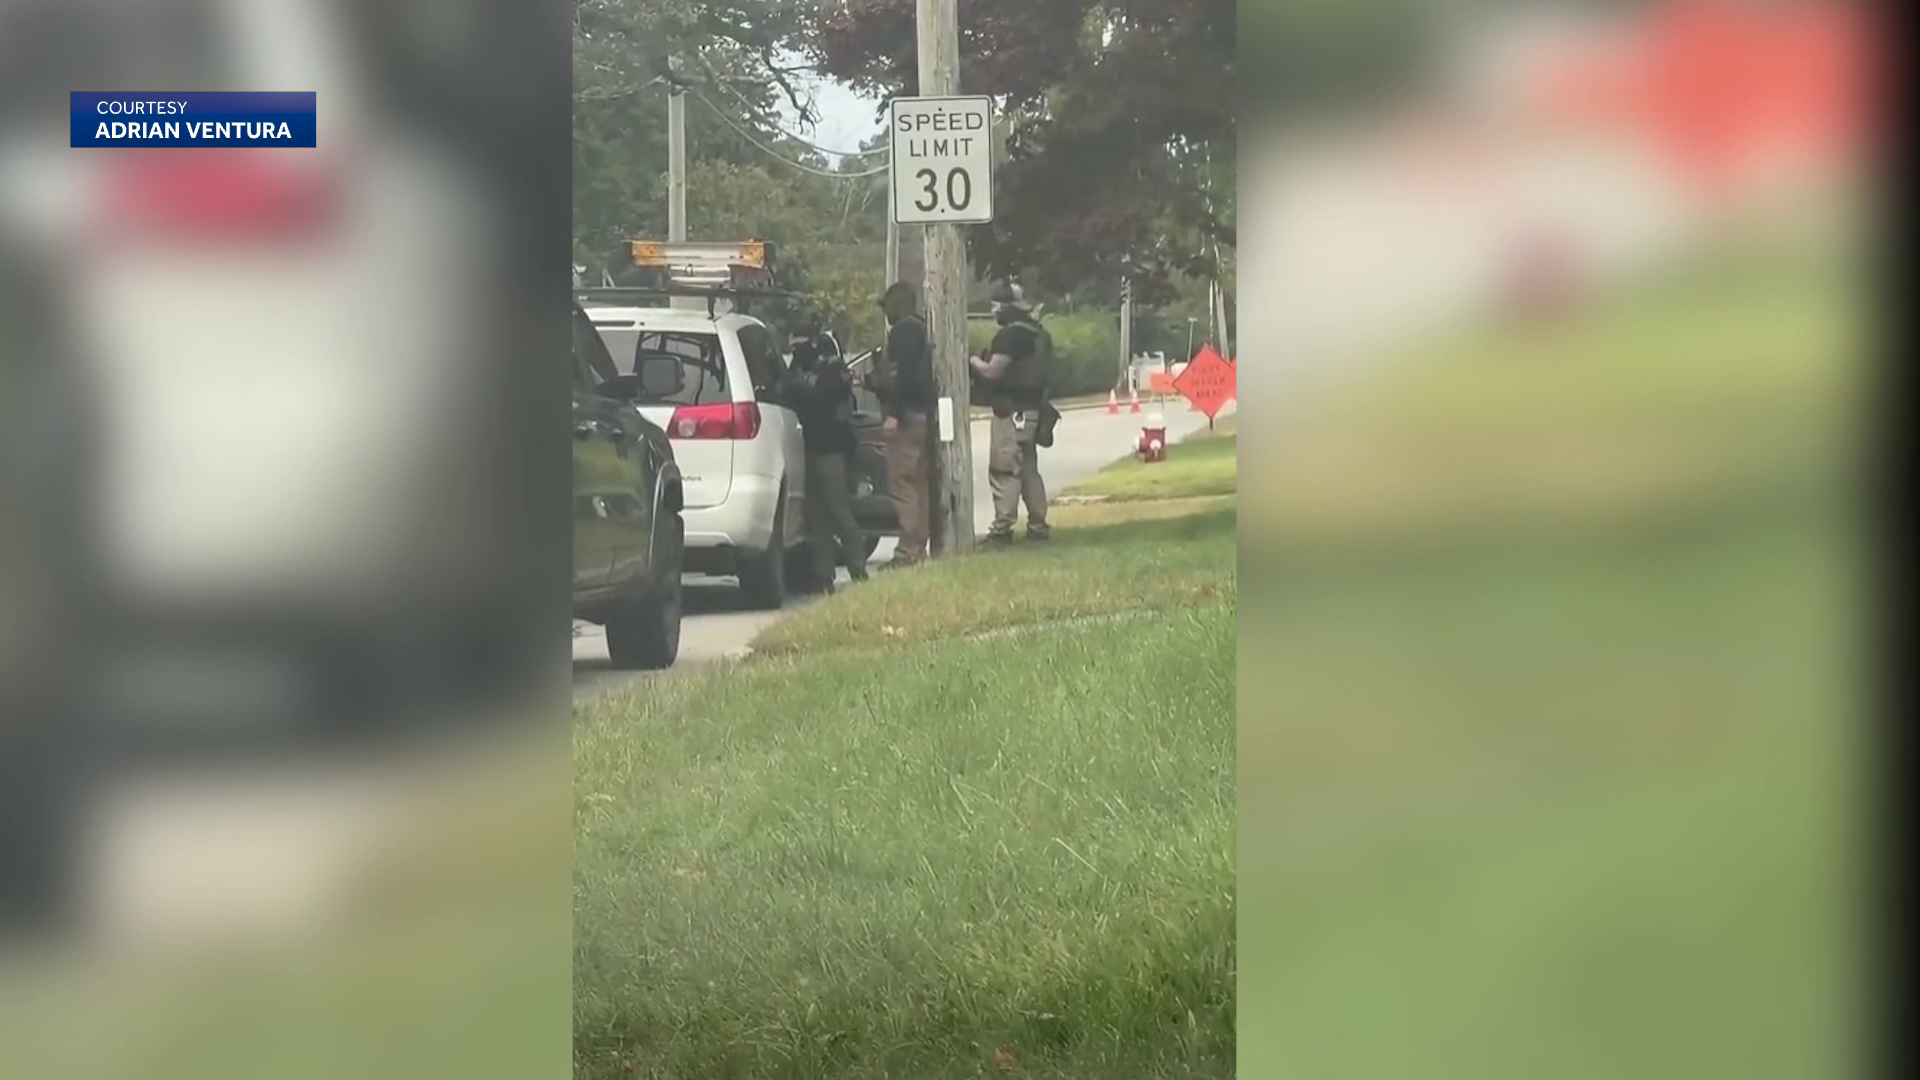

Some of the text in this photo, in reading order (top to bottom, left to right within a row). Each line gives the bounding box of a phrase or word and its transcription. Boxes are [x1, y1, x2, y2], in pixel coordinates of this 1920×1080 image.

[898, 112, 983, 132] SPEED
[909, 138, 973, 157] LIMIT
[914, 166, 971, 212] 30
